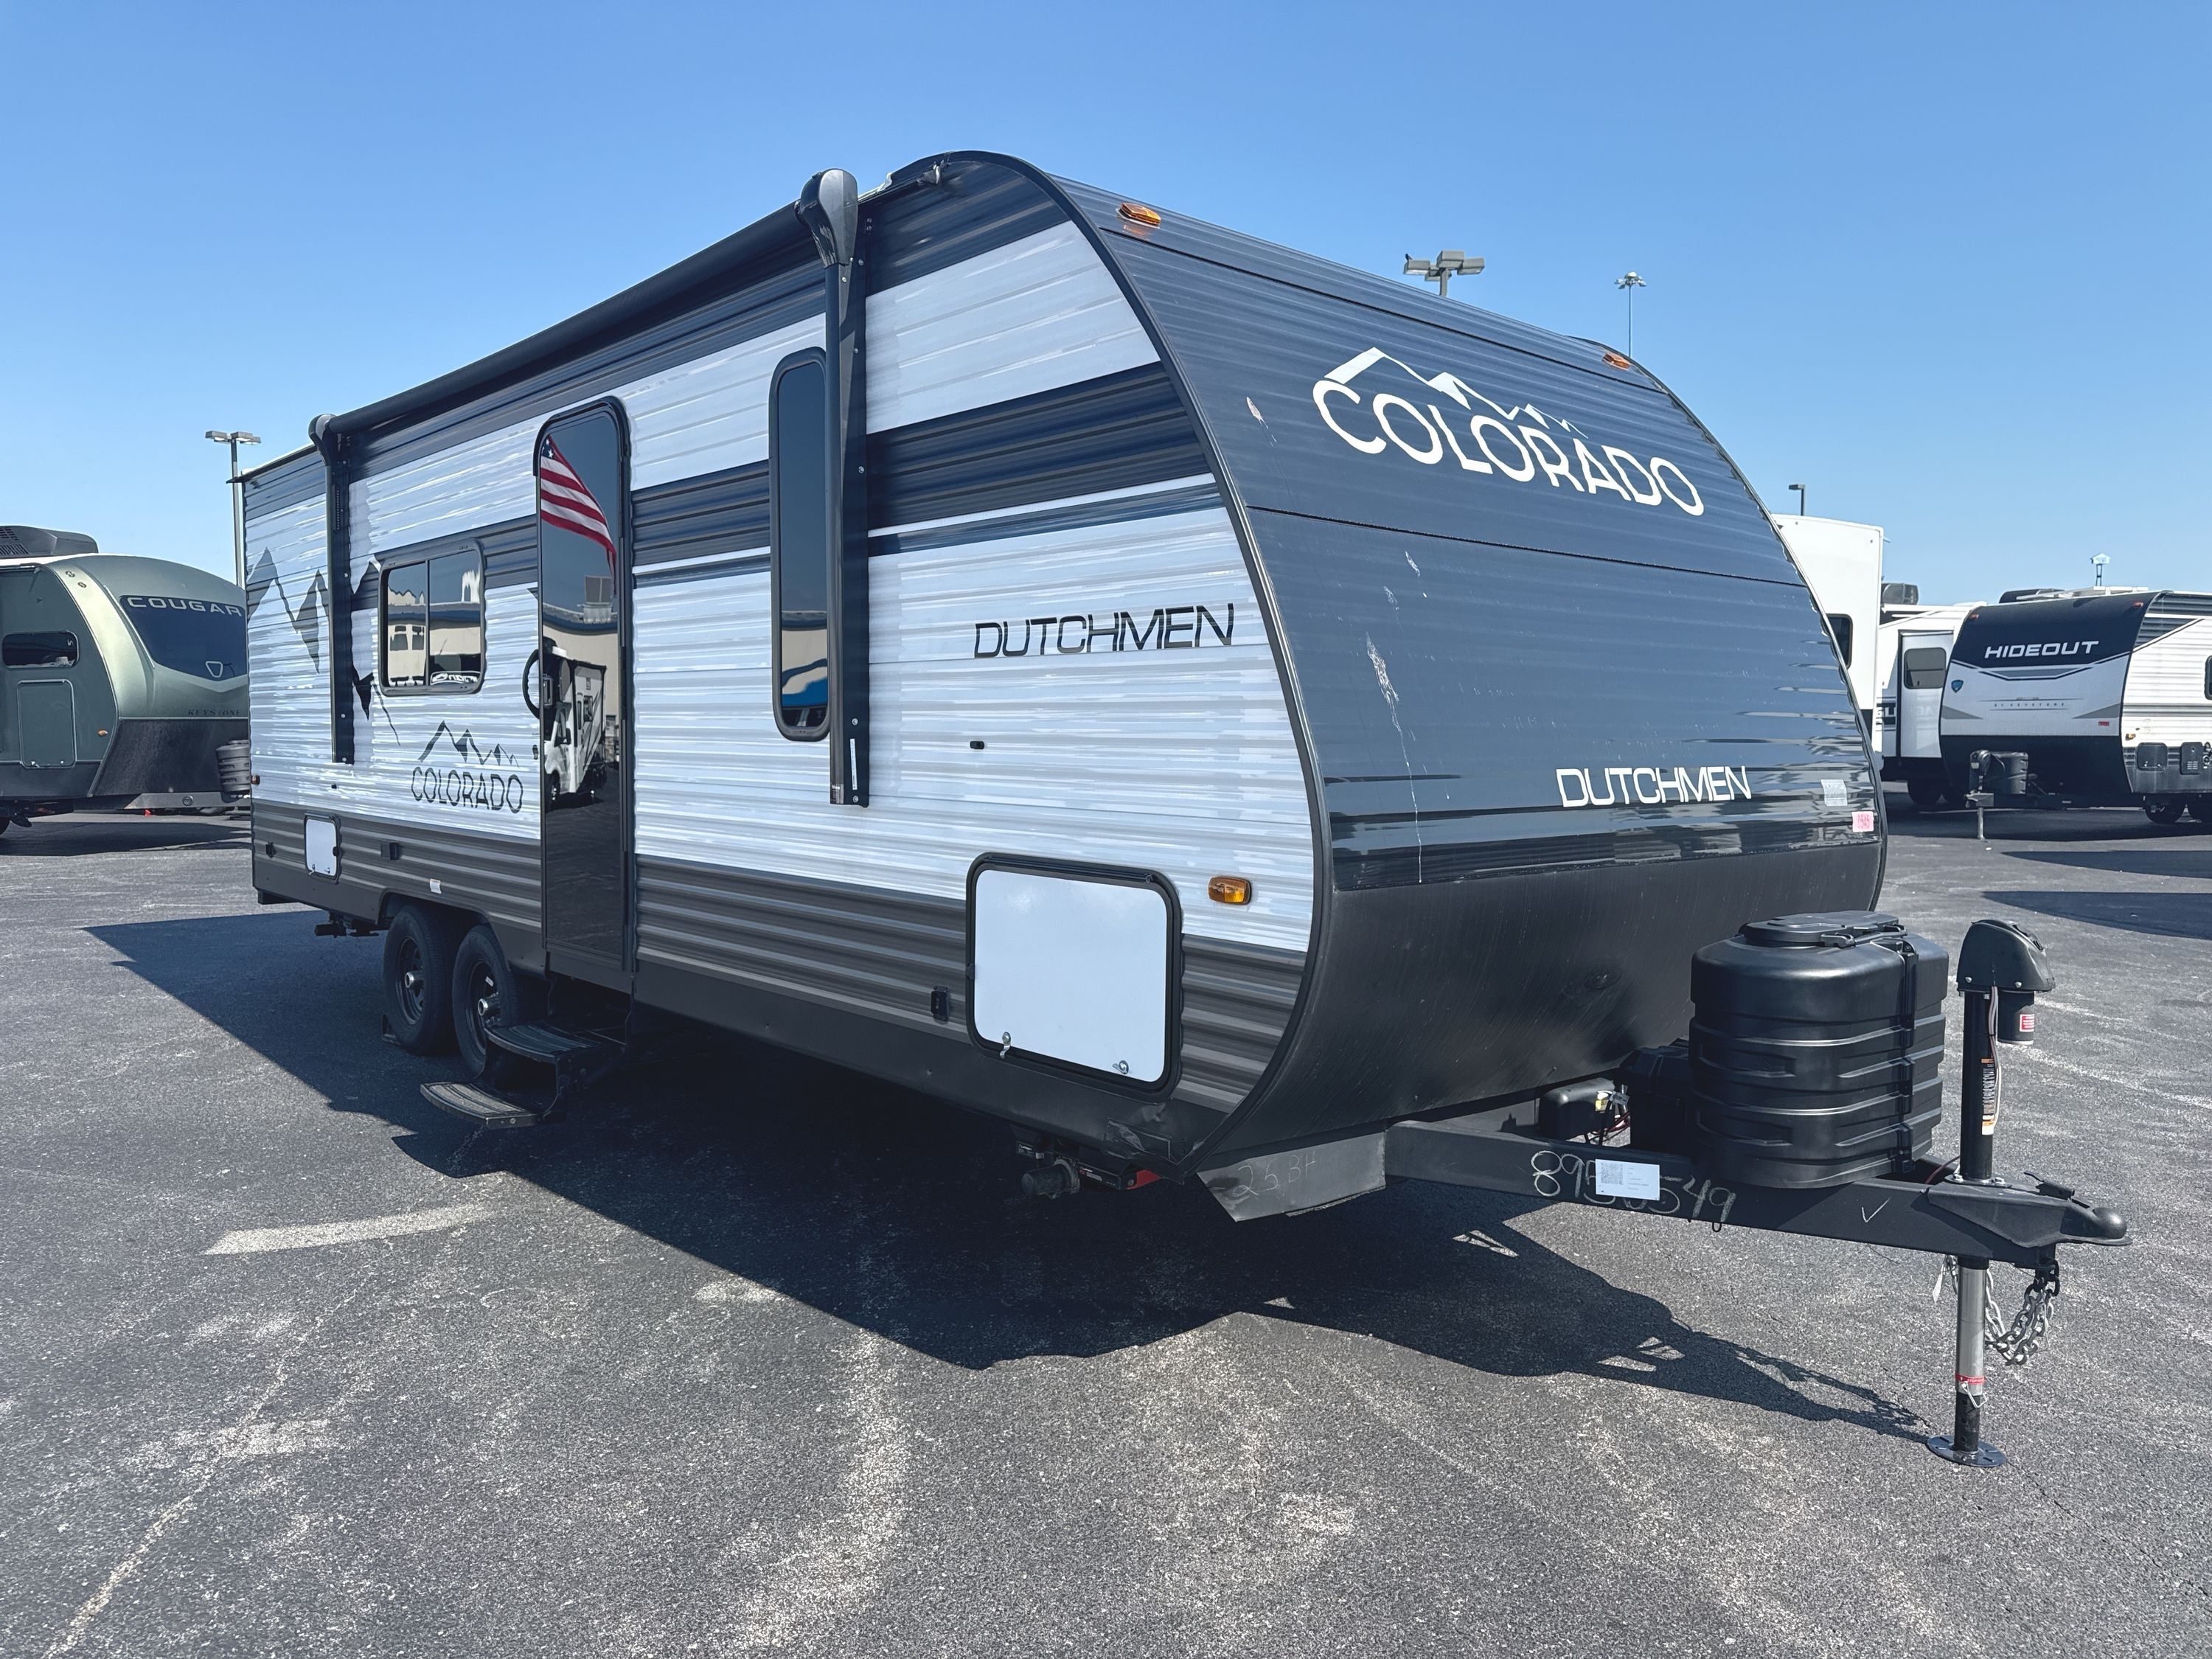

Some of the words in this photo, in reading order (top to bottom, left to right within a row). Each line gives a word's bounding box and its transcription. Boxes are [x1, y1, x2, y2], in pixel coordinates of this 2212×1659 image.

[1312, 380, 1705, 516] COLORADO
[127, 597, 243, 617] COUGAR
[974, 602, 1234, 658] DUTCHMEN
[1984, 640, 2099, 658] HIDEOUT
[411, 766, 524, 813] COLORADO
[1555, 765, 1752, 807] DUTCHMEN
